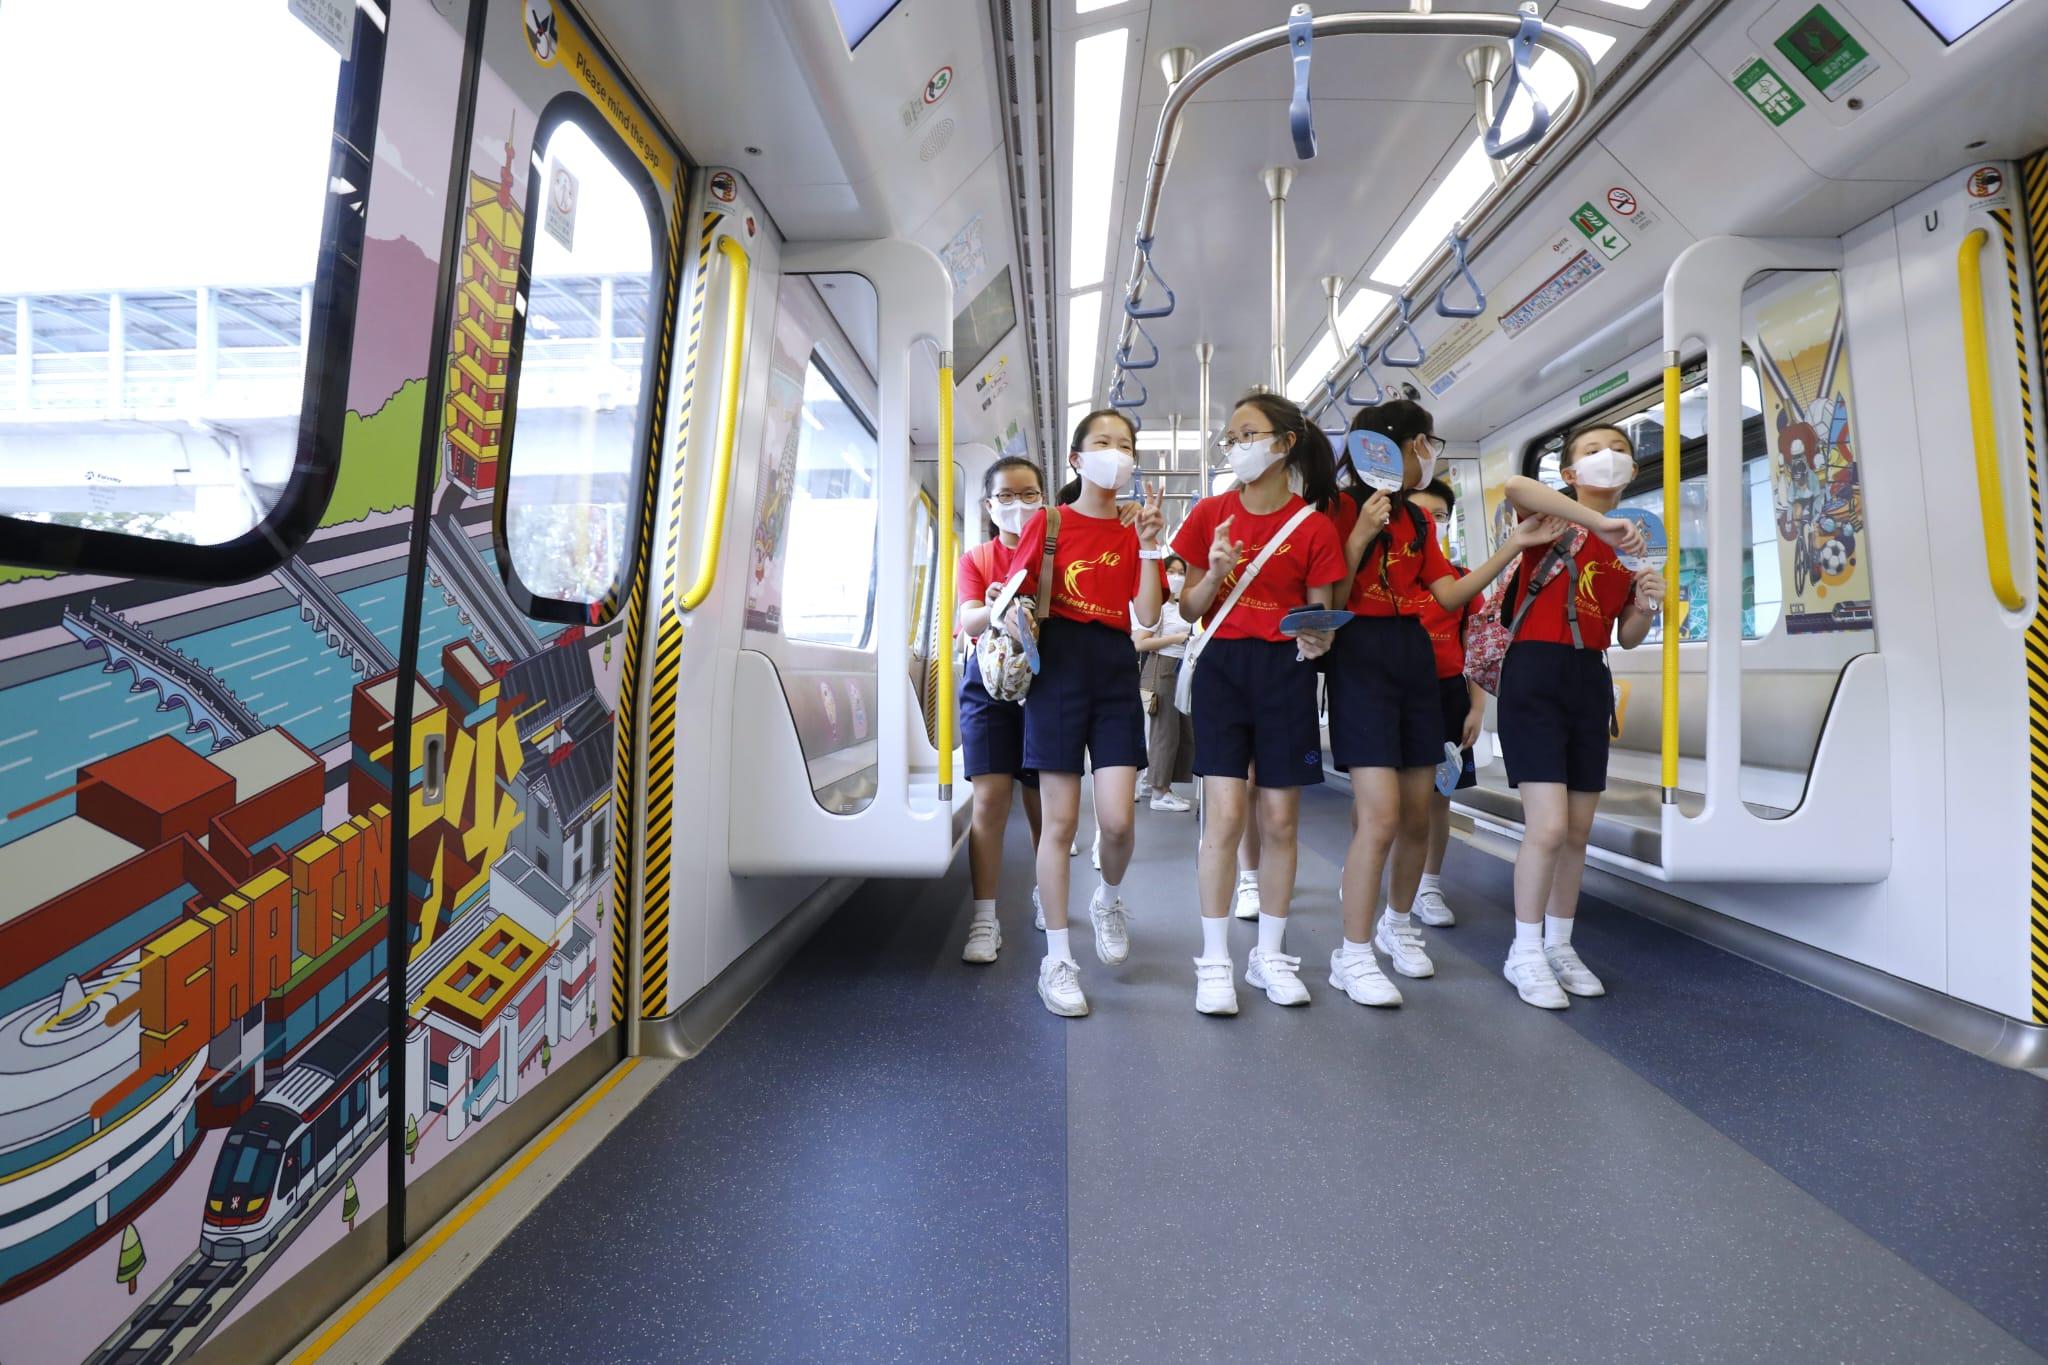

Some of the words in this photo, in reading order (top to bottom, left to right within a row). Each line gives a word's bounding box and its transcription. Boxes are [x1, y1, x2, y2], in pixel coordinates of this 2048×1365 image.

[576, 52, 606, 101] Please
[607, 96, 630, 129] mind
[630, 123, 644, 149] the
[644, 144, 660, 168] gap
[1925, 209, 1939, 232] U
